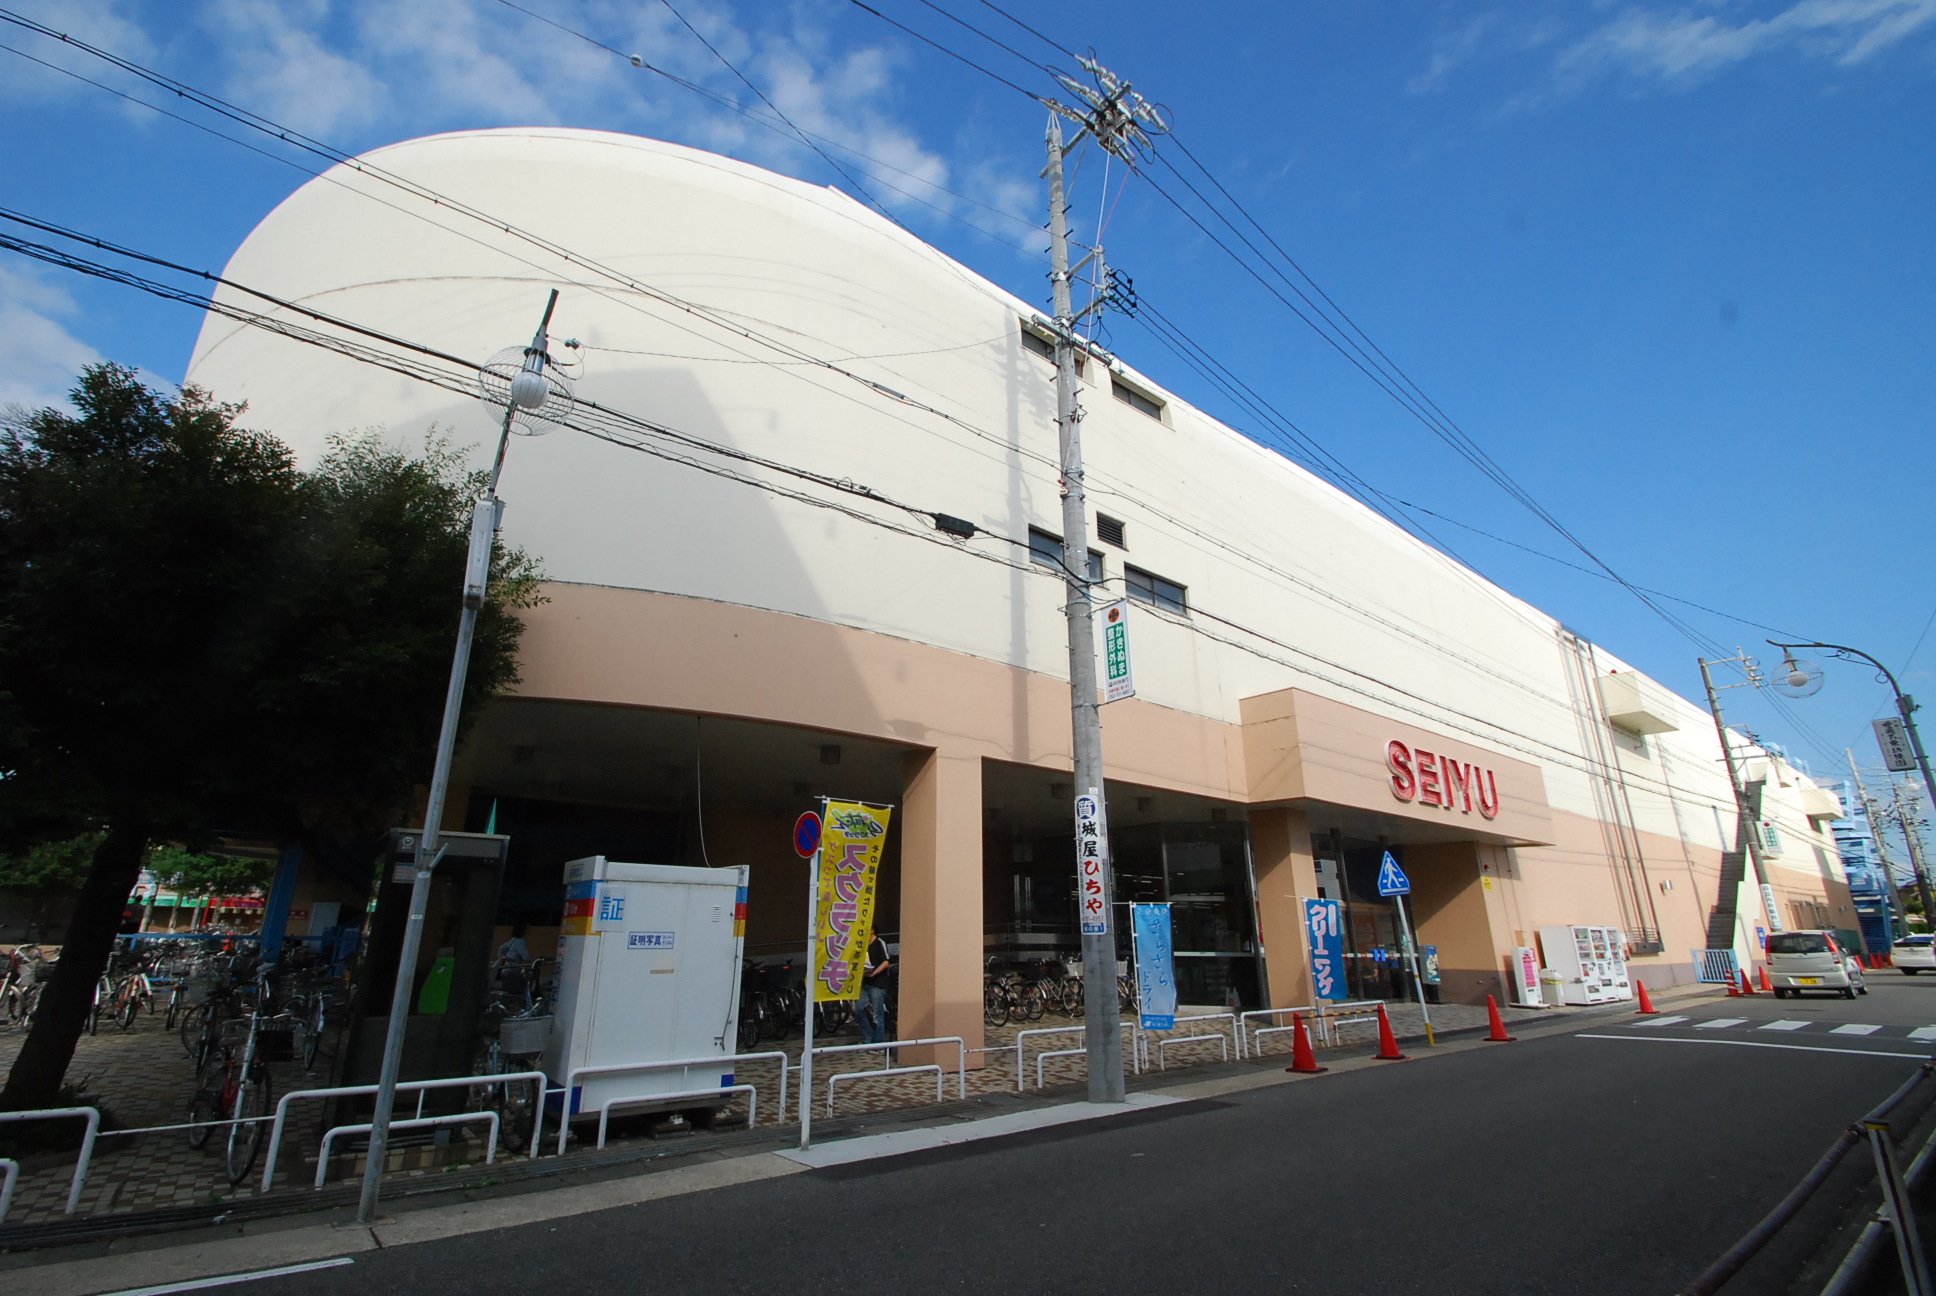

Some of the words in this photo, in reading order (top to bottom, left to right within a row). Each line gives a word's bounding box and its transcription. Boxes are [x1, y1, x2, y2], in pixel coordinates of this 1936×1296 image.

[1107, 628, 1118, 679] 整形外科
[1115, 624, 1126, 675] かきぬま
[1384, 740, 1499, 820] SEIYU
[1082, 821, 1103, 914] 城屋ひちや
[600, 896, 625, 921] 証
[629, 934, 661, 946] 証明写真
[1147, 919, 1169, 988] さらさら
[1309, 904, 1335, 996] クリーニング
[1142, 970, 1153, 1010] ドライ
